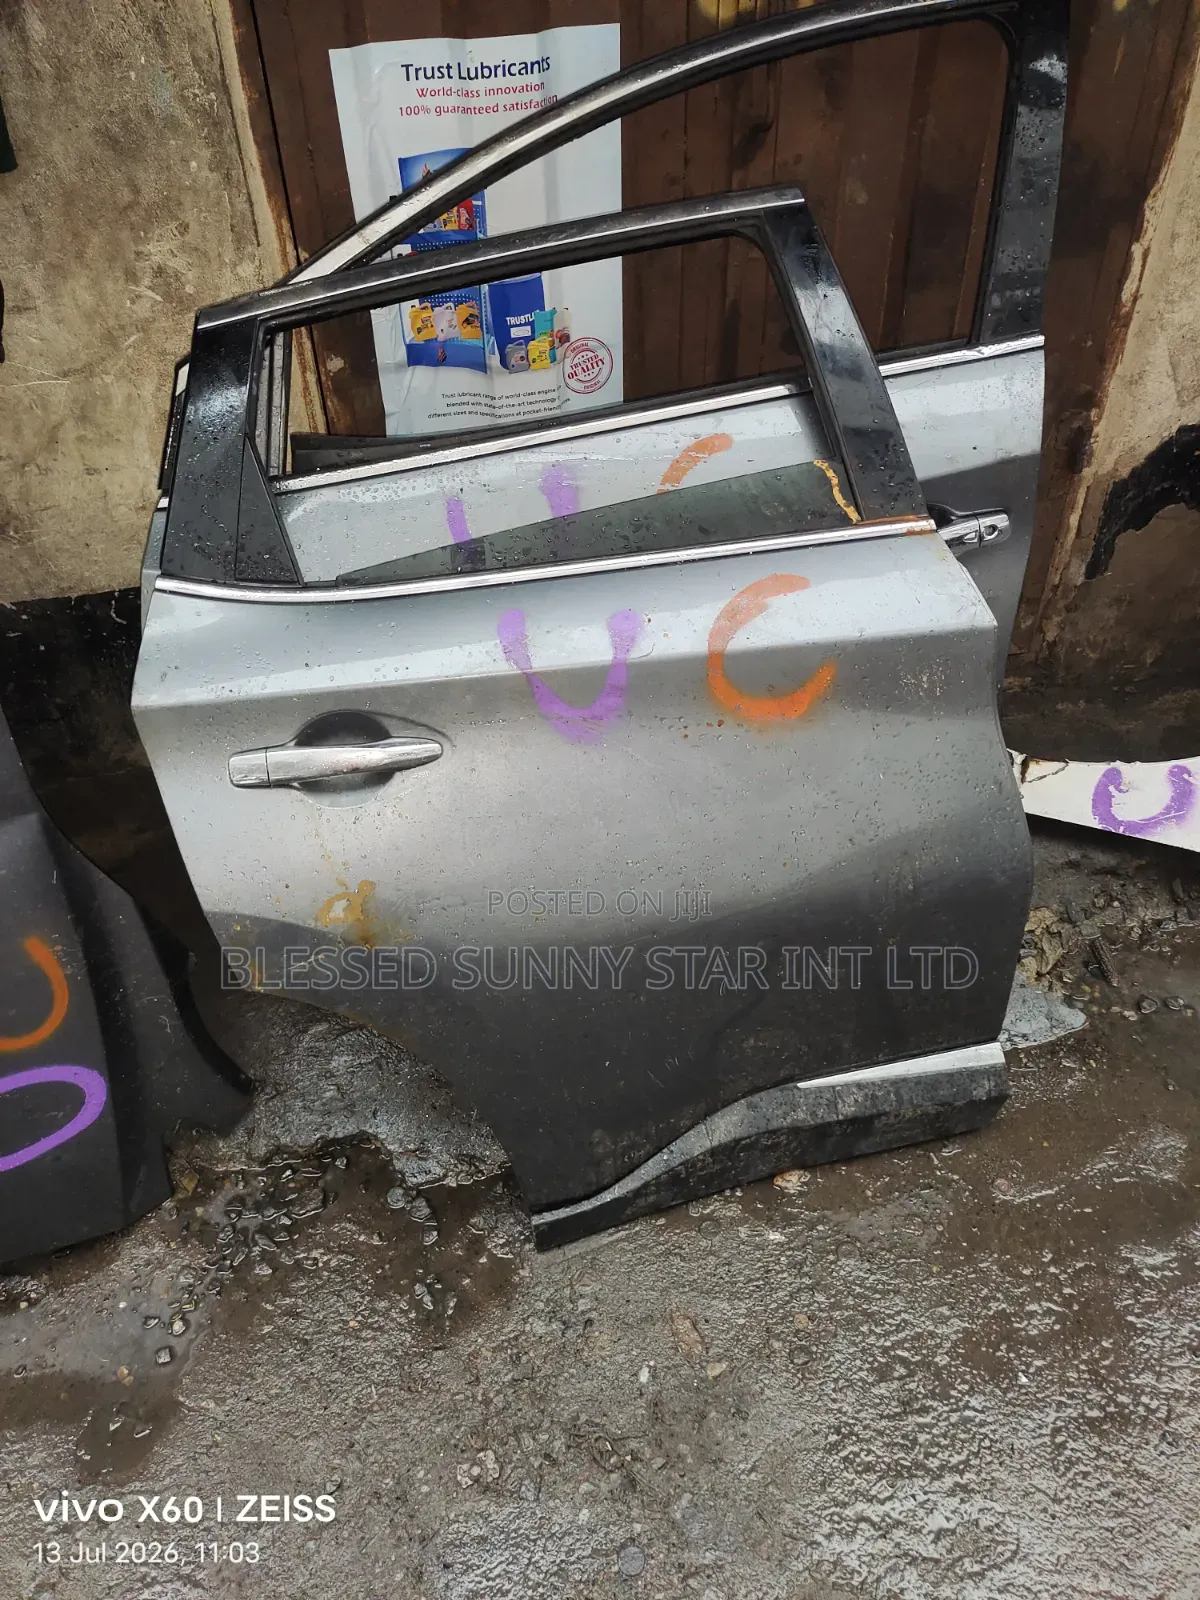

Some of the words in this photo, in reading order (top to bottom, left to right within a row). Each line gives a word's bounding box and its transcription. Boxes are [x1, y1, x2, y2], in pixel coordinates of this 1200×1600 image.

[400, 62, 453, 82] Trust
[457, 55, 551, 81] Lubricants
[416, 86, 481, 98] World-class
[484, 81, 545, 97] innovation
[399, 104, 432, 117] 100%
[434, 103, 499, 117] guaranteed
[502, 94, 558, 112] satisfaction
[567, 357, 605, 380] QUALITY
[569, 353, 599, 371] TRUSTED
[441, 391, 457, 399] Trust
[504, 391, 537, 400] world-class
[537, 387, 556, 396] engine
[446, 400, 470, 408] blended
[427, 411, 452, 419] different
